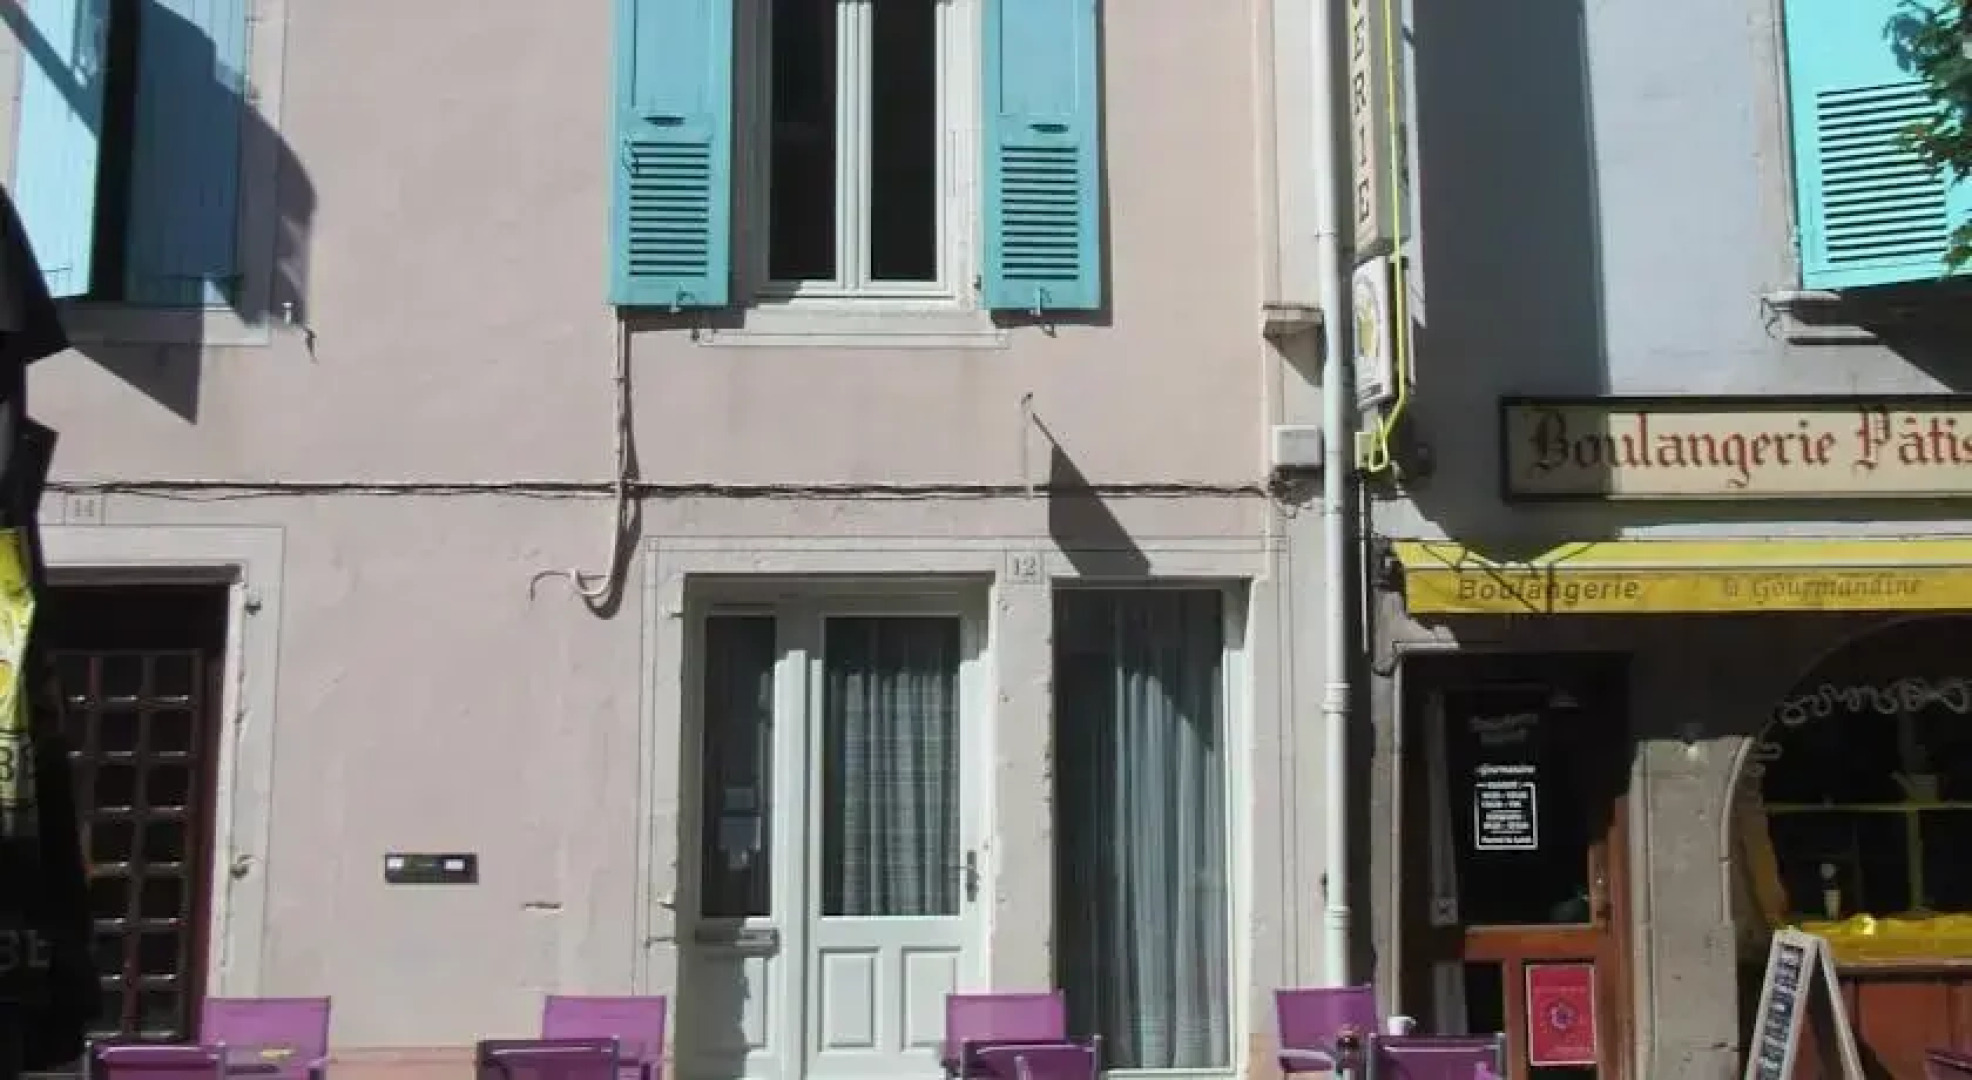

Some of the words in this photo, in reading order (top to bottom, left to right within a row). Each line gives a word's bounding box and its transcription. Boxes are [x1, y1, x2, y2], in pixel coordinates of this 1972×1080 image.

[1352, 0, 1370, 225] ERIE
[1525, 406, 1837, 488] Boulangerie
[1013, 557, 1036, 576] 12
